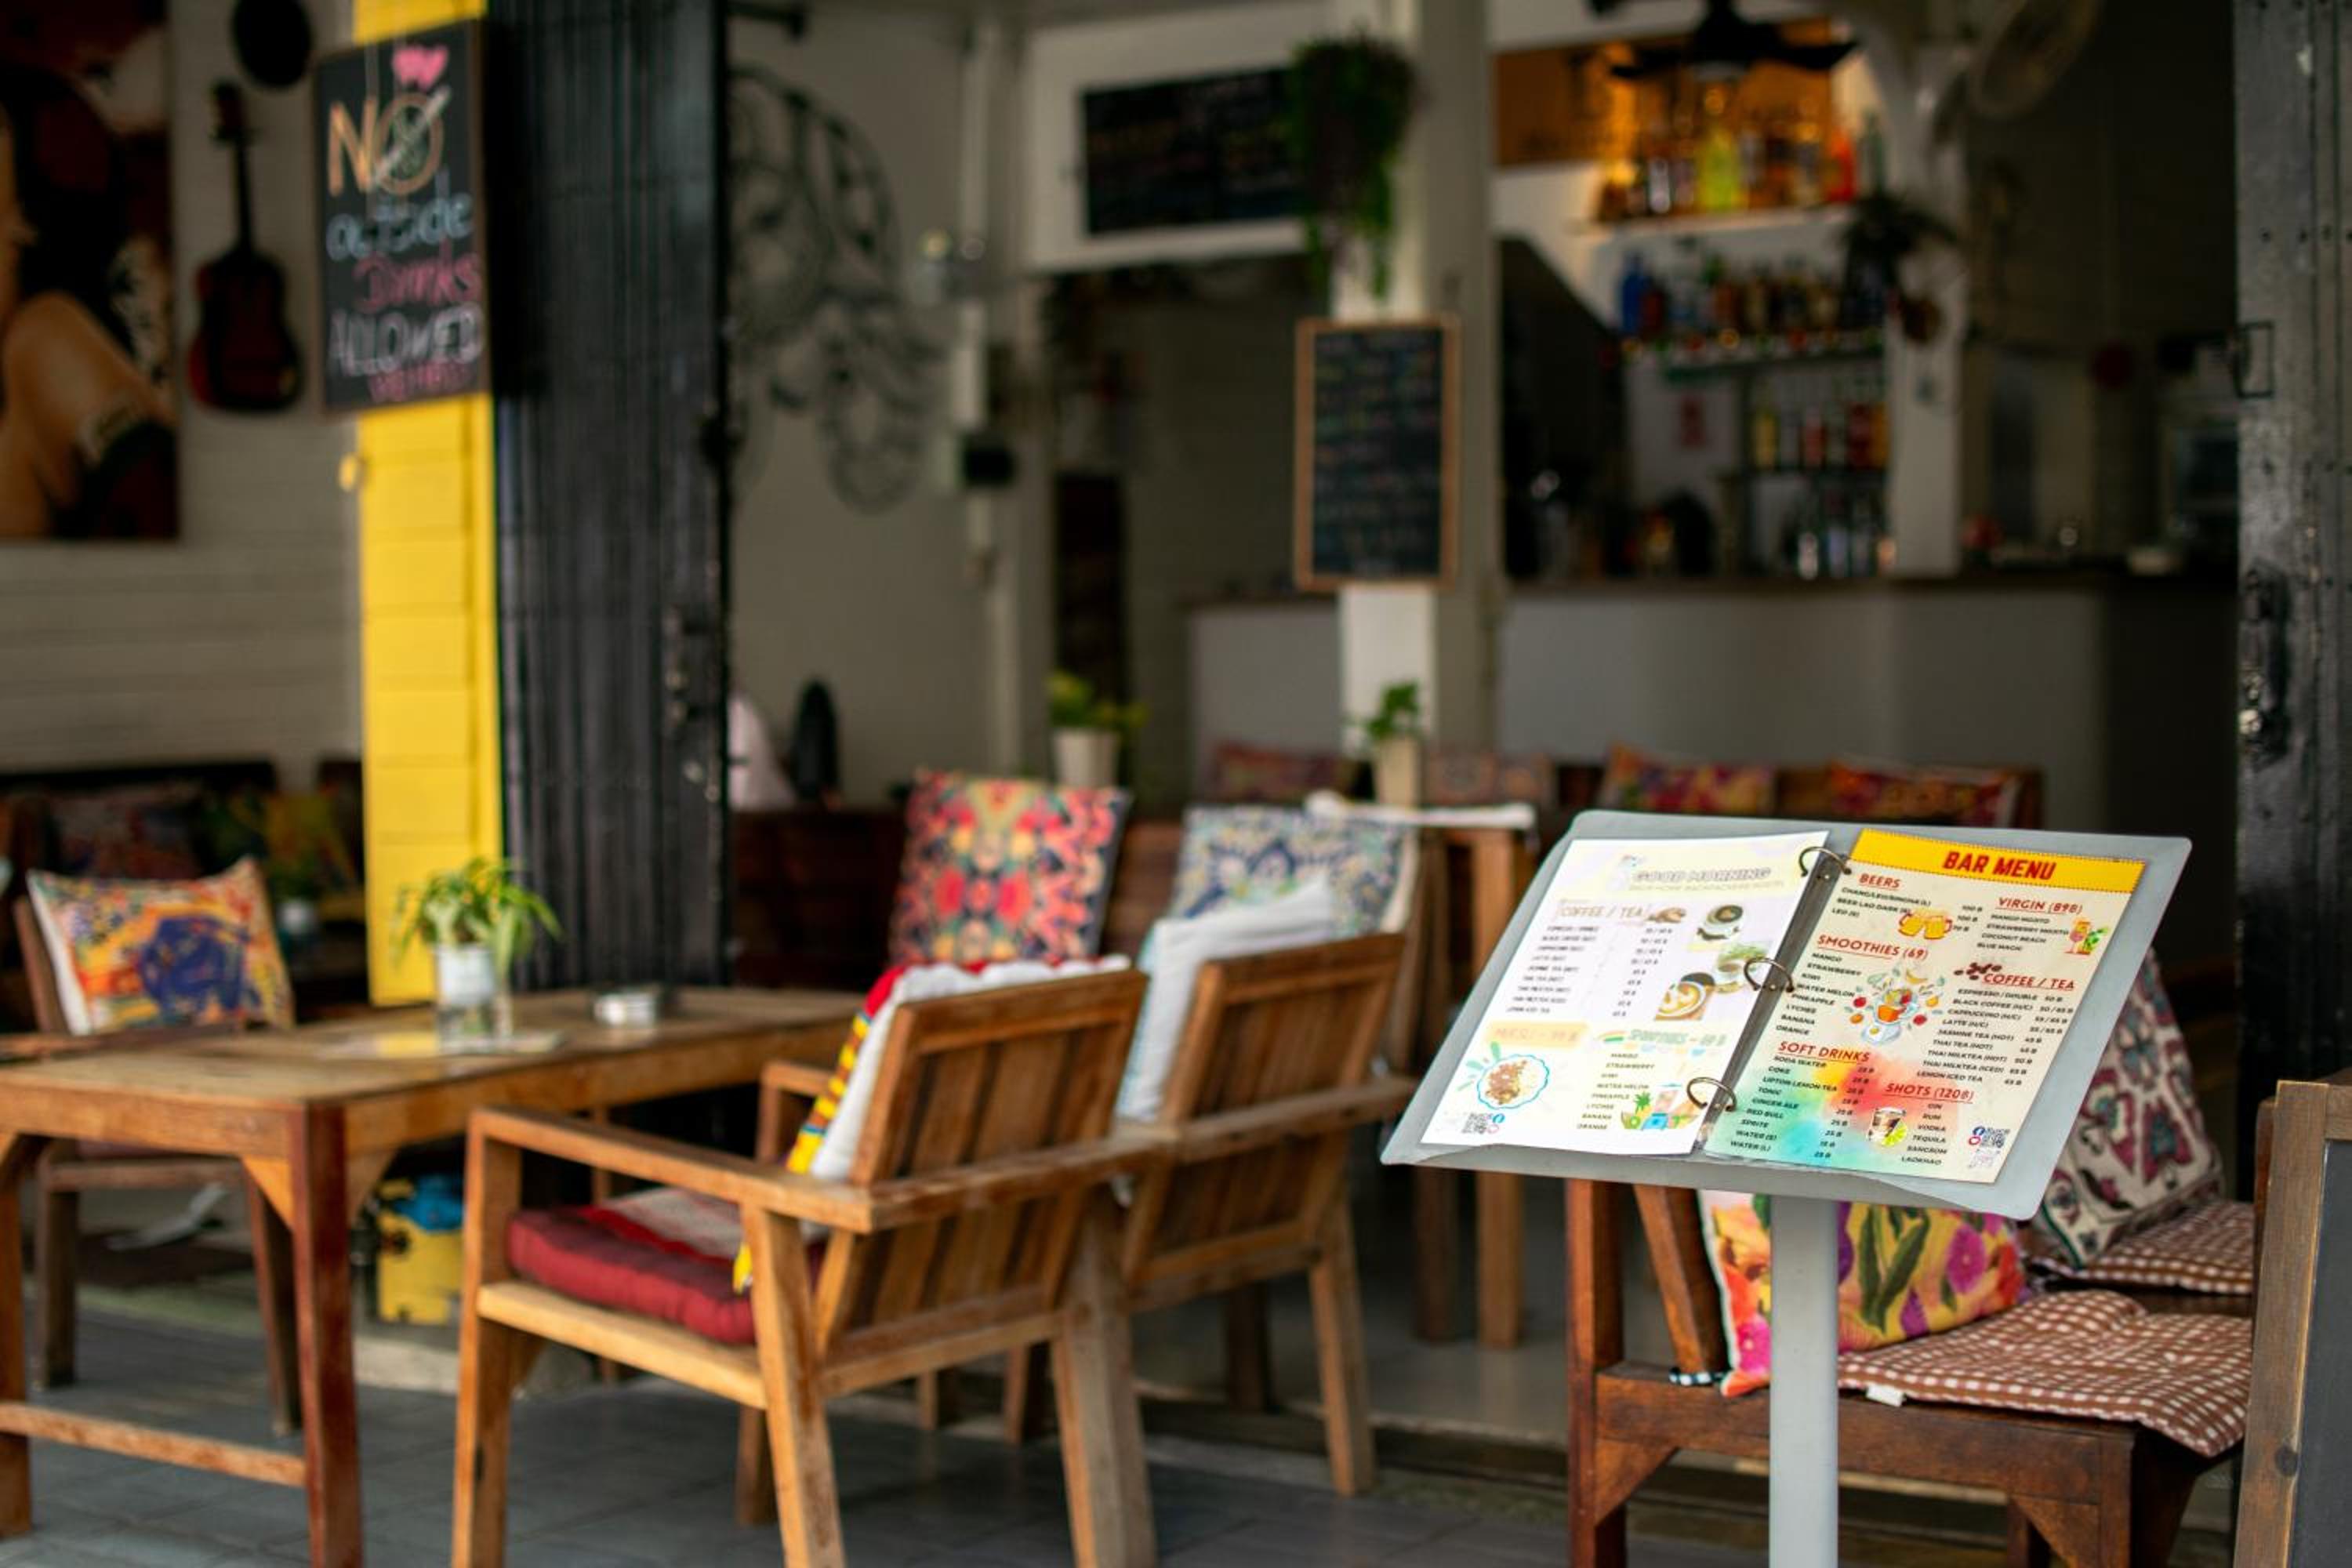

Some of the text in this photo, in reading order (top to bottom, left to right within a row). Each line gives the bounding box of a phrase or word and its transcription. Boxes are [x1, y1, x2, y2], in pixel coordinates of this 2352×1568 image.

[1942, 851, 2056, 880] BAR MENU
[1859, 874, 1901, 888] BEERS
[1998, 898, 2045, 910] VIRGIN
[1560, 906, 1603, 916] COFFEE
[1621, 907, 1642, 917] TEA
[1818, 935, 1929, 960] SMOOTHIES (69)
[1813, 953, 1842, 961] MANGO
[1807, 963, 1861, 975] STRAWBERRY
[1984, 974, 2033, 985] COFFEE
[2051, 978, 2074, 989] TEA
[1797, 983, 1855, 997] WATER MELON
[1958, 989, 1999, 997] ESPRESSO
[1791, 993, 1835, 1005] PINEAPPLE
[1786, 1004, 1817, 1014] LYCHEE
[1947, 1009, 1999, 1018] CAPPUCCINO
[1781, 1014, 1815, 1025] BANANA
[1776, 1025, 1809, 1035] ORANGE
[1779, 1041, 1871, 1062] SOFT DRINKS
[1793, 1080, 1820, 1089] LEMON
[1886, 1083, 1930, 1096] SHOTS
[1752, 1098, 1782, 1107] GINGER
[1912, 1134, 1946, 1143] TEQUILA
[1731, 1141, 1759, 1149] WATER
